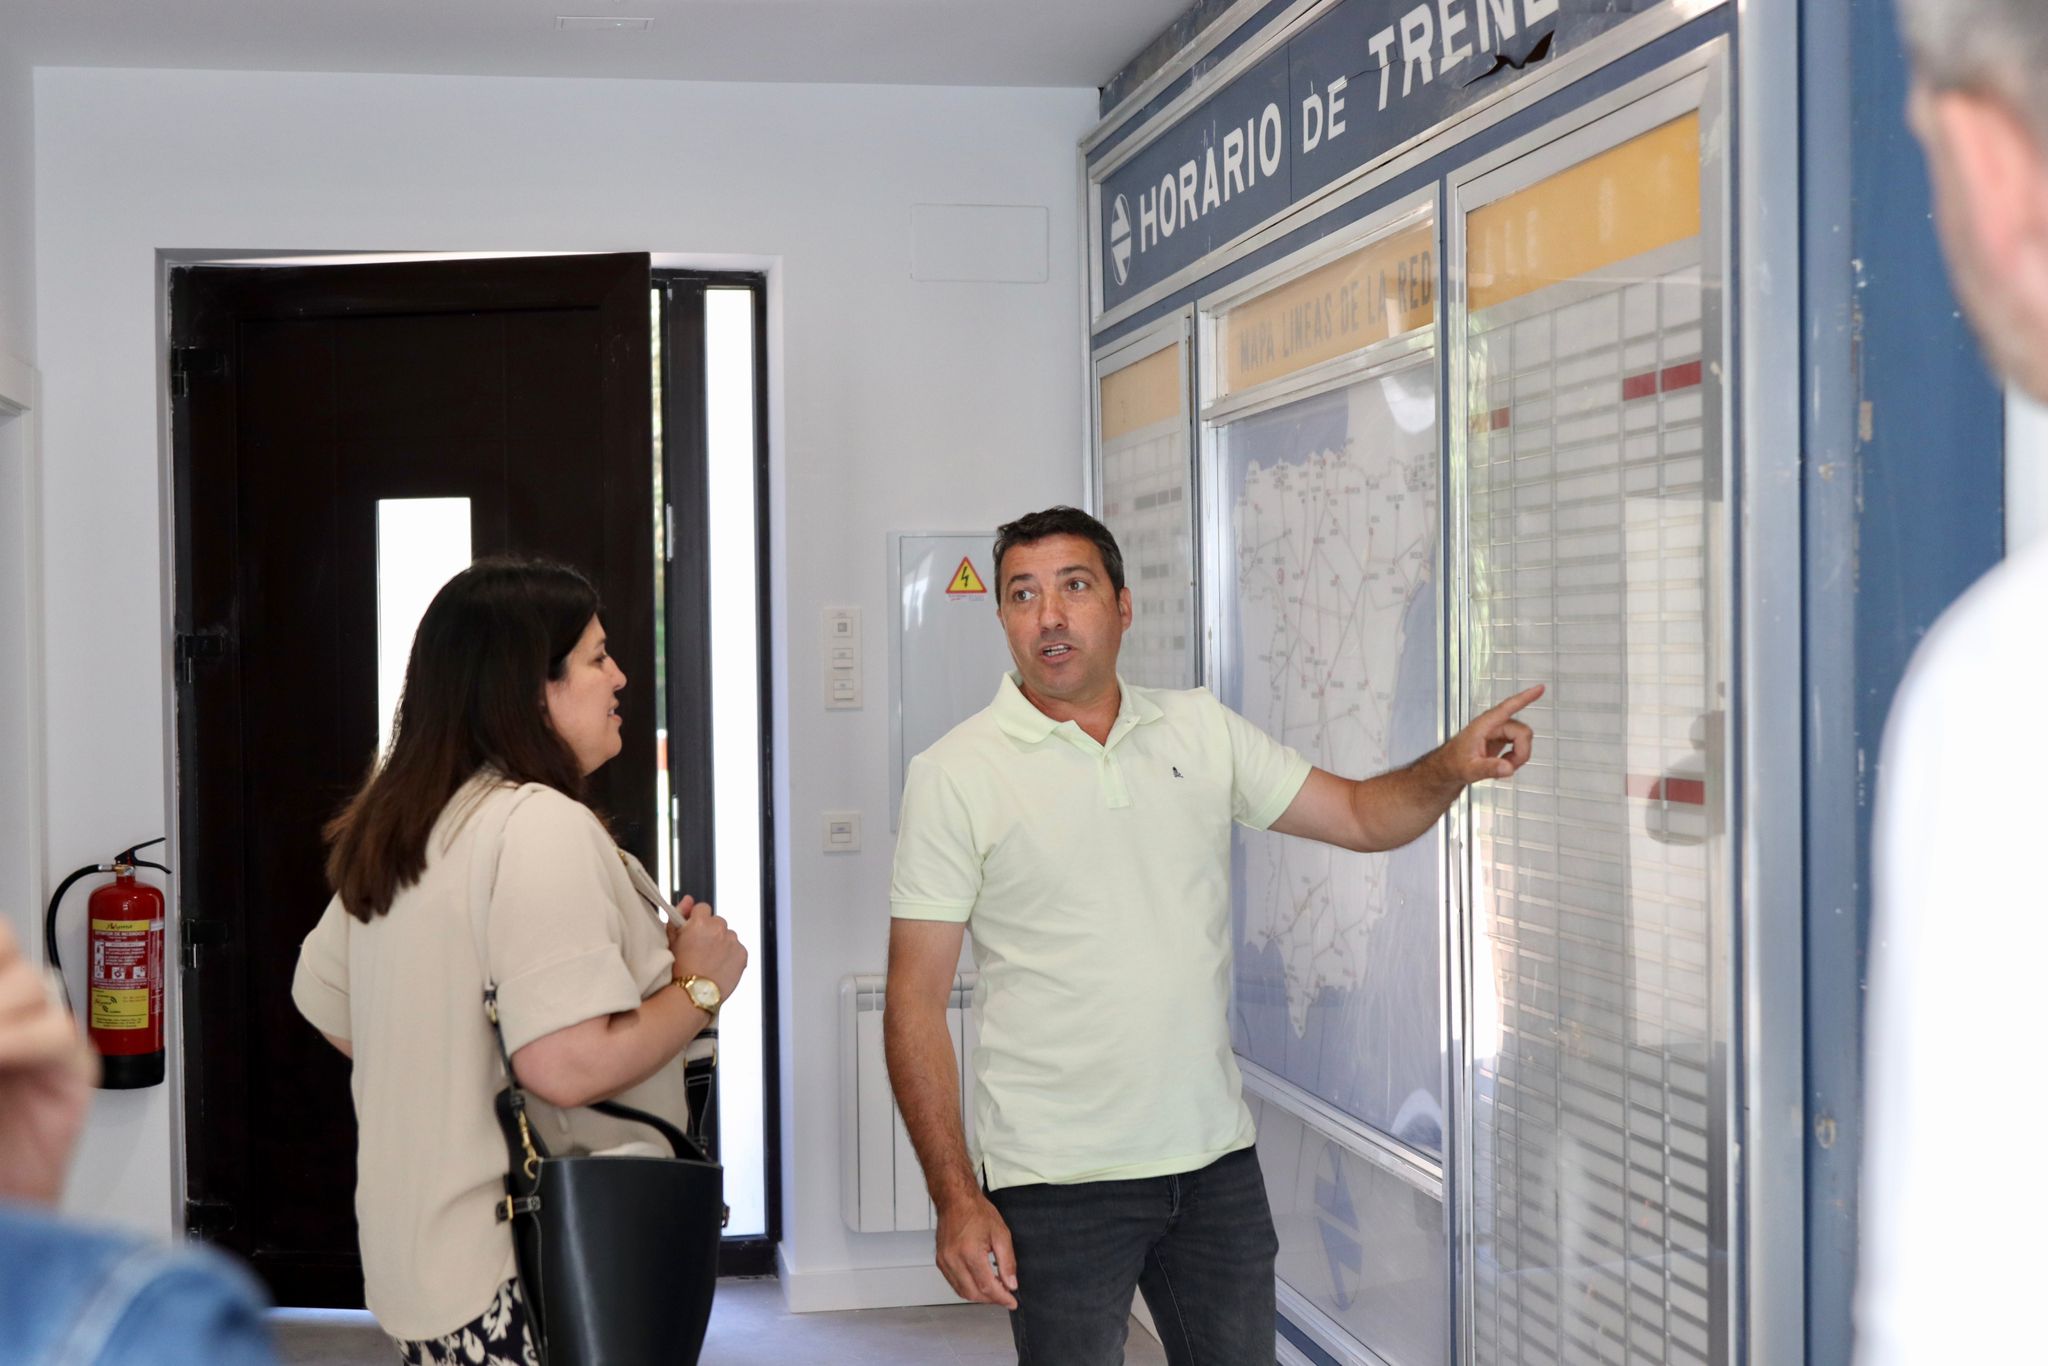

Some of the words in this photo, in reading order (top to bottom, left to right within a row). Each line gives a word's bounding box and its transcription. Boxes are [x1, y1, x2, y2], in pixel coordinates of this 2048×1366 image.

[1140, 103, 1281, 253] HORARIO
[1303, 76, 1347, 153] DE
[1241, 320, 1275, 375] MAPA
[1282, 293, 1332, 358] LINEAS
[1340, 280, 1360, 336] DE
[1368, 269, 1388, 326] LA
[1398, 250, 1431, 314] RED
